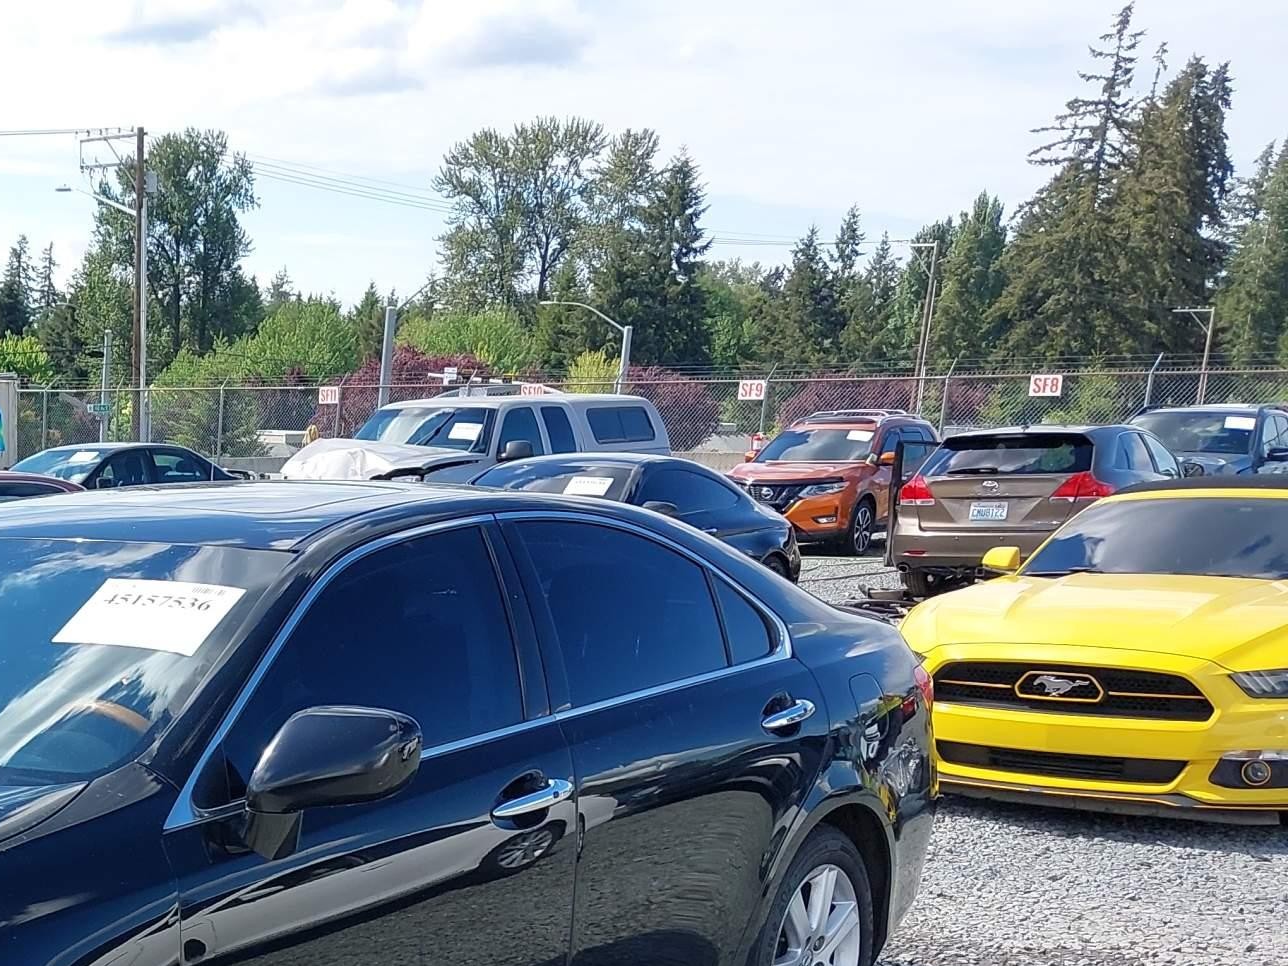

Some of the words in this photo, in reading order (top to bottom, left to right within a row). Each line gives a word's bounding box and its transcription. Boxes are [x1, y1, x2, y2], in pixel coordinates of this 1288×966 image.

[740, 382, 763, 397] SF9
[1032, 377, 1059, 393] SF8
[320, 389, 337, 402] SF11
[103, 592, 213, 612] 45157536
